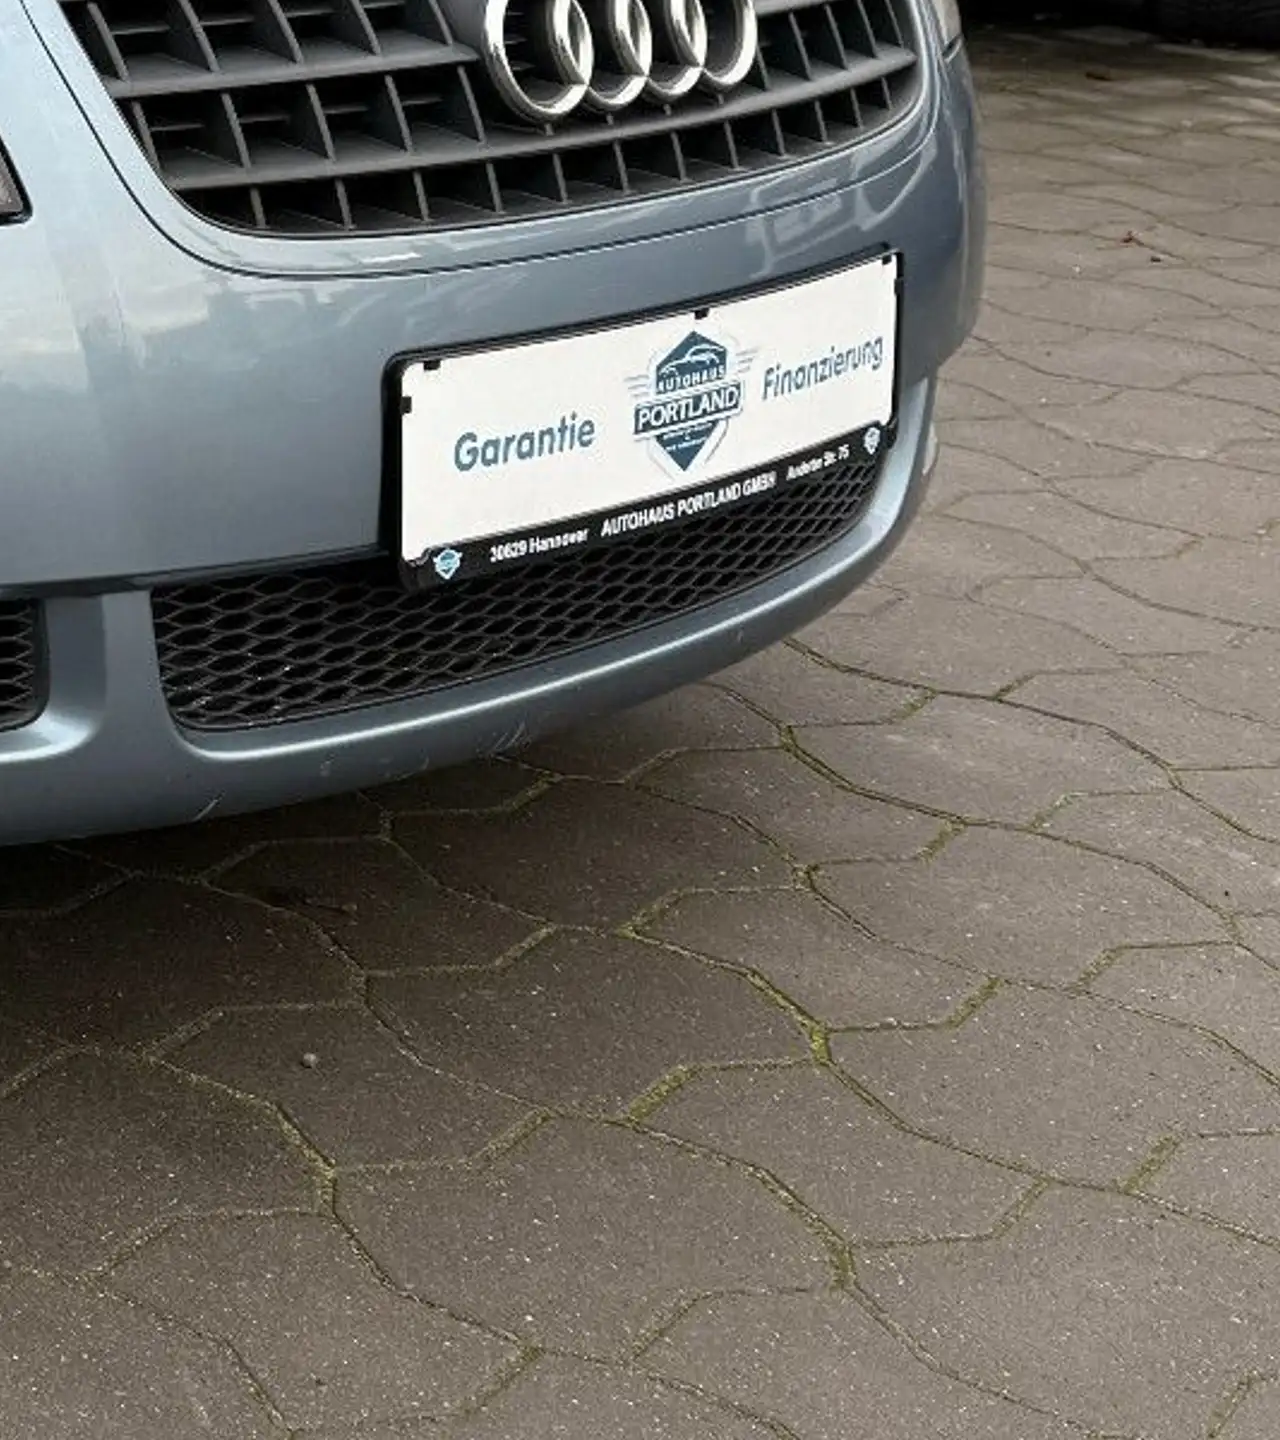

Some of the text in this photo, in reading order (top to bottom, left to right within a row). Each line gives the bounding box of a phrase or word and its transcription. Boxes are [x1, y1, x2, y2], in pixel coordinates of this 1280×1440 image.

[657, 364, 725, 392] AUTOHAUS
[761, 335, 884, 401] Finanzierung
[638, 385, 739, 430] PORTLAND
[453, 410, 596, 472] Garantie
[600, 501, 675, 537] AUTOHAUS
[677, 481, 740, 517] PORTLAND
